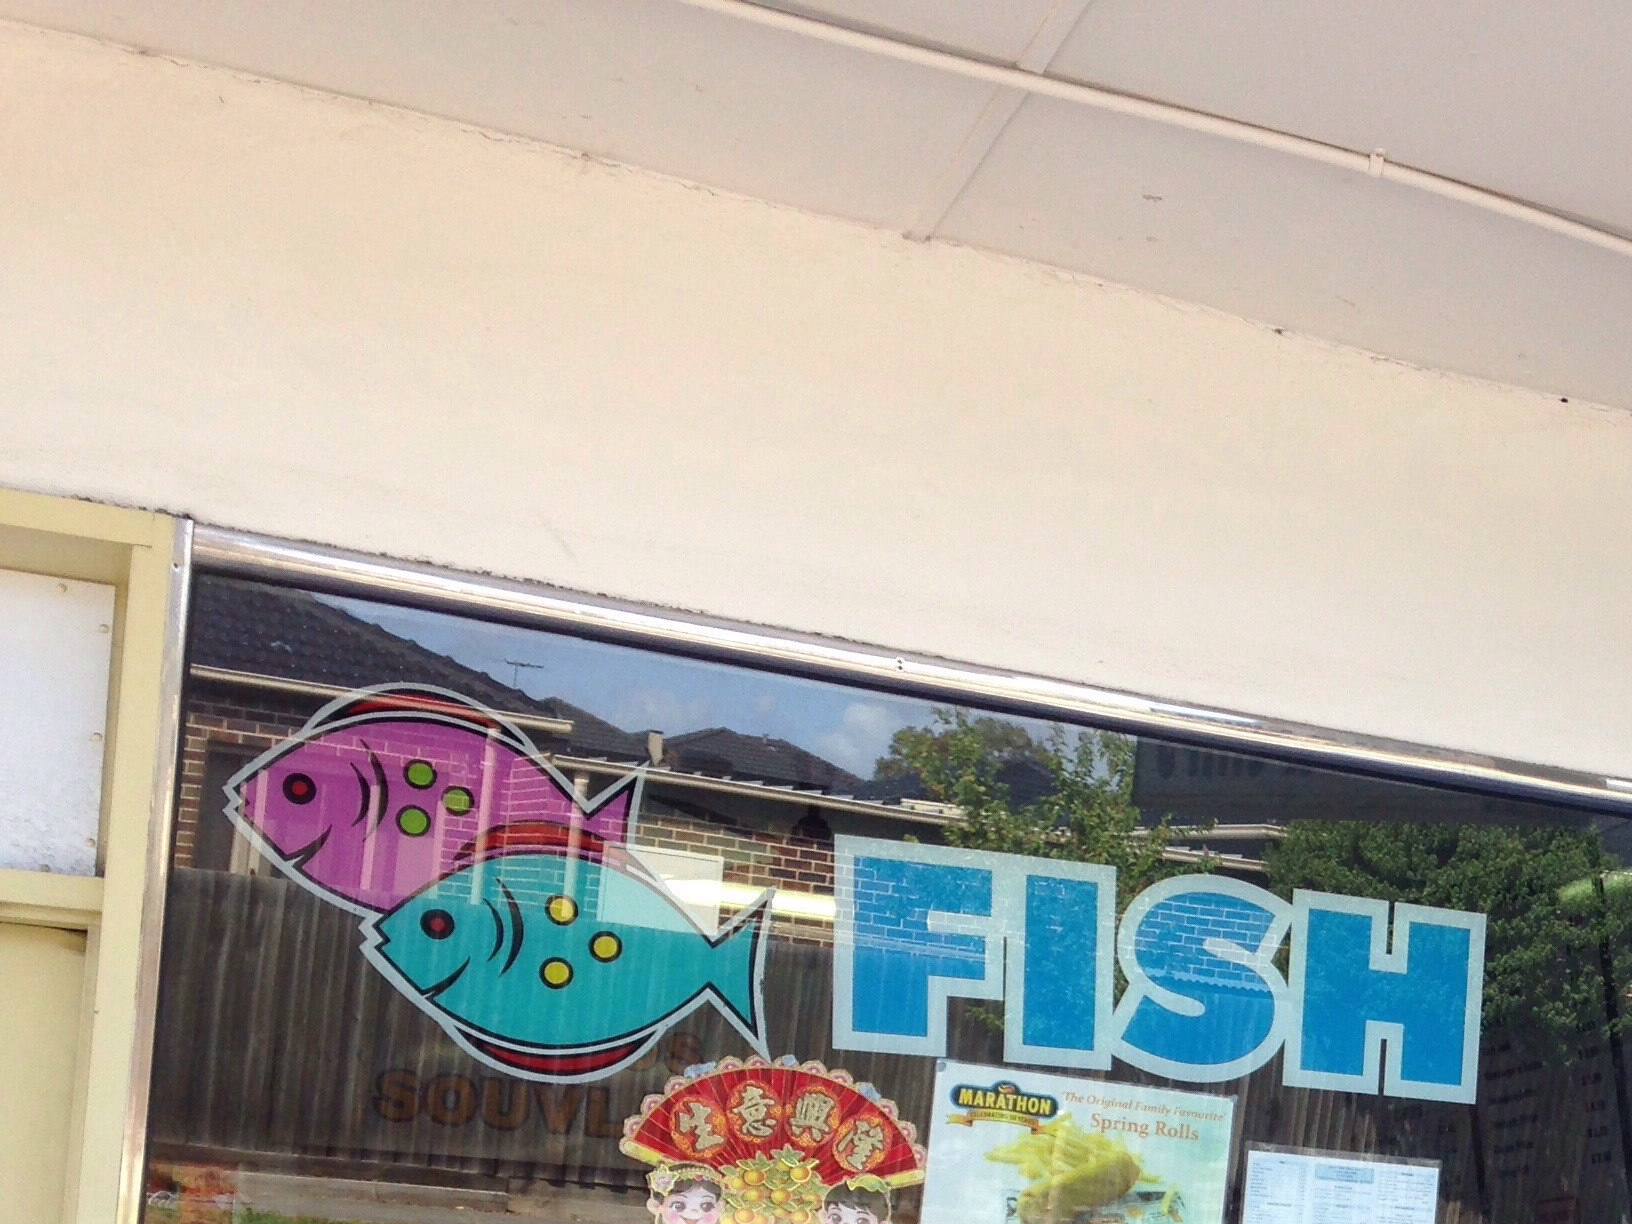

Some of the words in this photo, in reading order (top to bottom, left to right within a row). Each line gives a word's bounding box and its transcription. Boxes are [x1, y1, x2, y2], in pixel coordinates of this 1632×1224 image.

[832, 835, 1486, 1104] FISH
[373, 1067, 624, 1139] SOUVL
[958, 1088, 1051, 1115] MARATHON
[1087, 1094, 1133, 1111] Original
[1135, 1101, 1171, 1117] Family
[1091, 1113, 1149, 1138] Spring
[1155, 1120, 1200, 1141] Rolls
